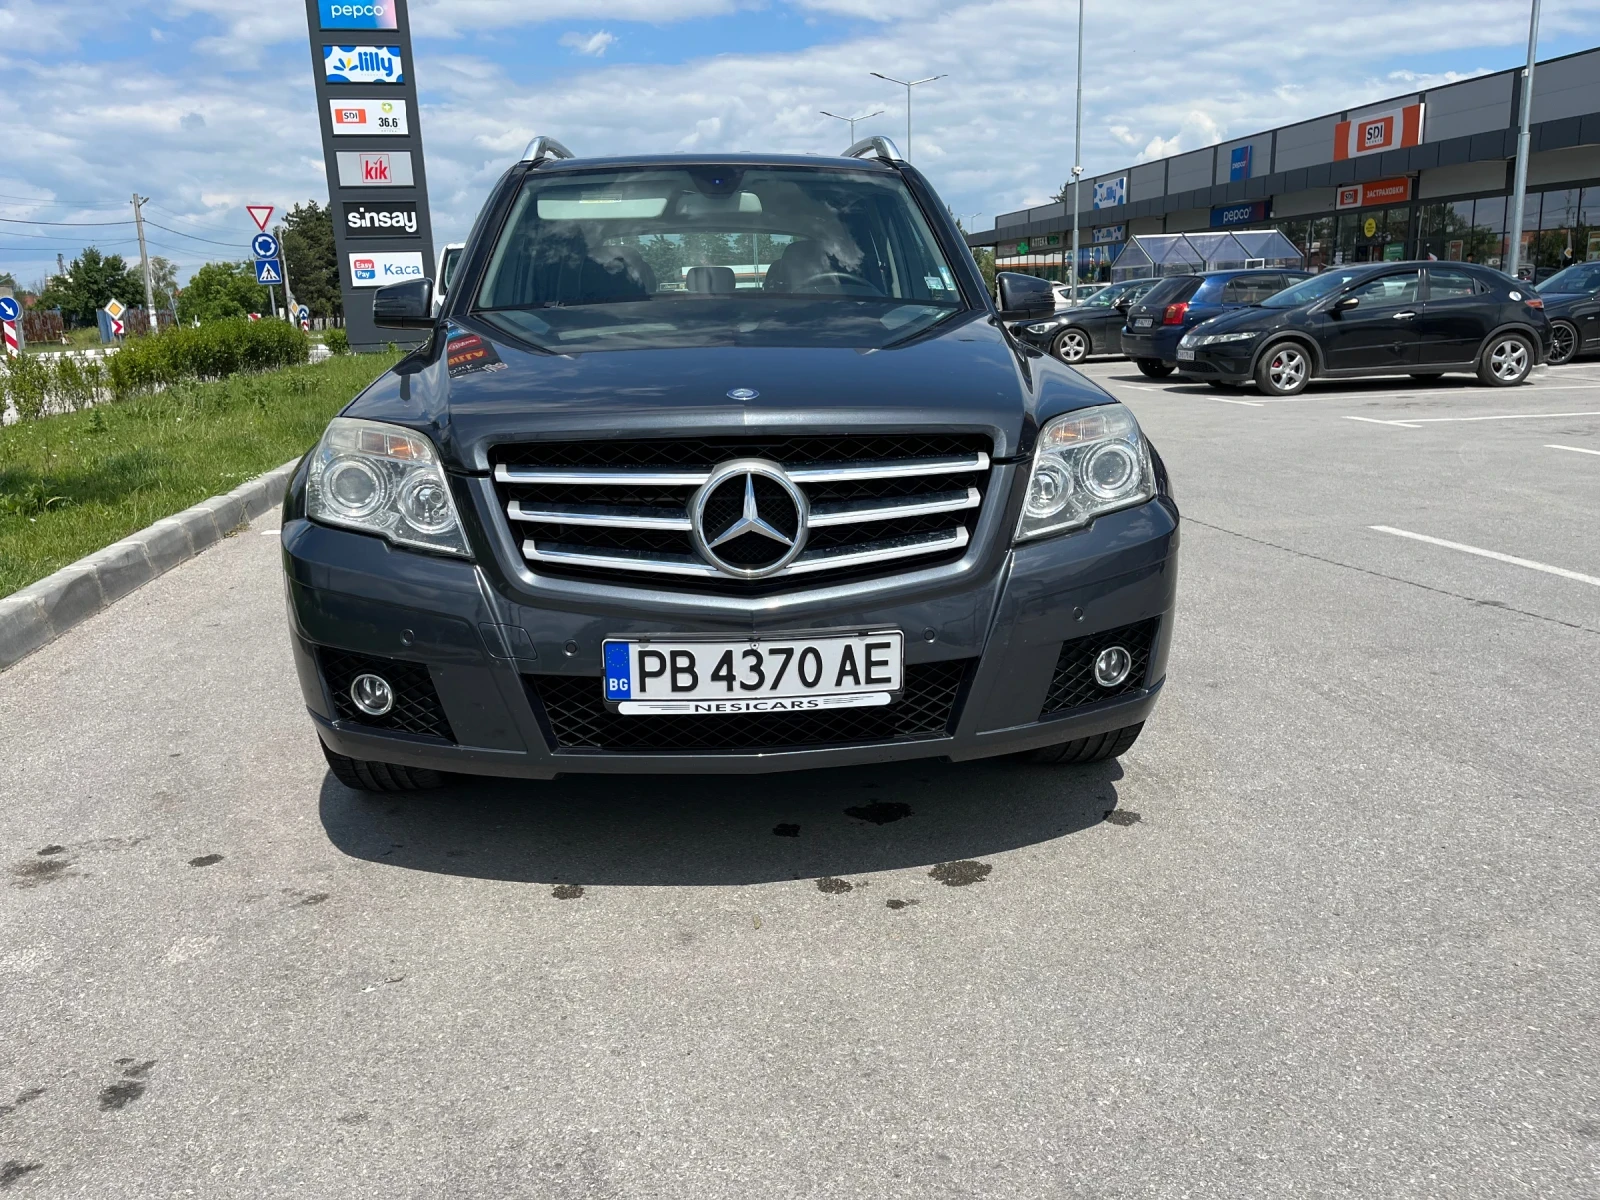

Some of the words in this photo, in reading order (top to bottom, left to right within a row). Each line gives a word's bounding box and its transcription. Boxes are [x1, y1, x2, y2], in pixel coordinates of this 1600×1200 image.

[331, 4, 384, 18] pepco
[358, 51, 394, 77] lilly
[343, 111, 358, 120] SDI
[1367, 124, 1383, 140] SDI
[1232, 160, 1247, 169] pepco
[1366, 186, 1404, 198] ЗАСТРАХОВКИ
[347, 207, 418, 233] sinsay
[1223, 208, 1250, 224] pepco
[355, 261, 373, 270] Easy
[638, 649, 699, 693] PB
[710, 646, 823, 692] 4370
[835, 641, 892, 687] AE
[609, 678, 629, 692] BG
[694, 699, 819, 713] NESICARS
